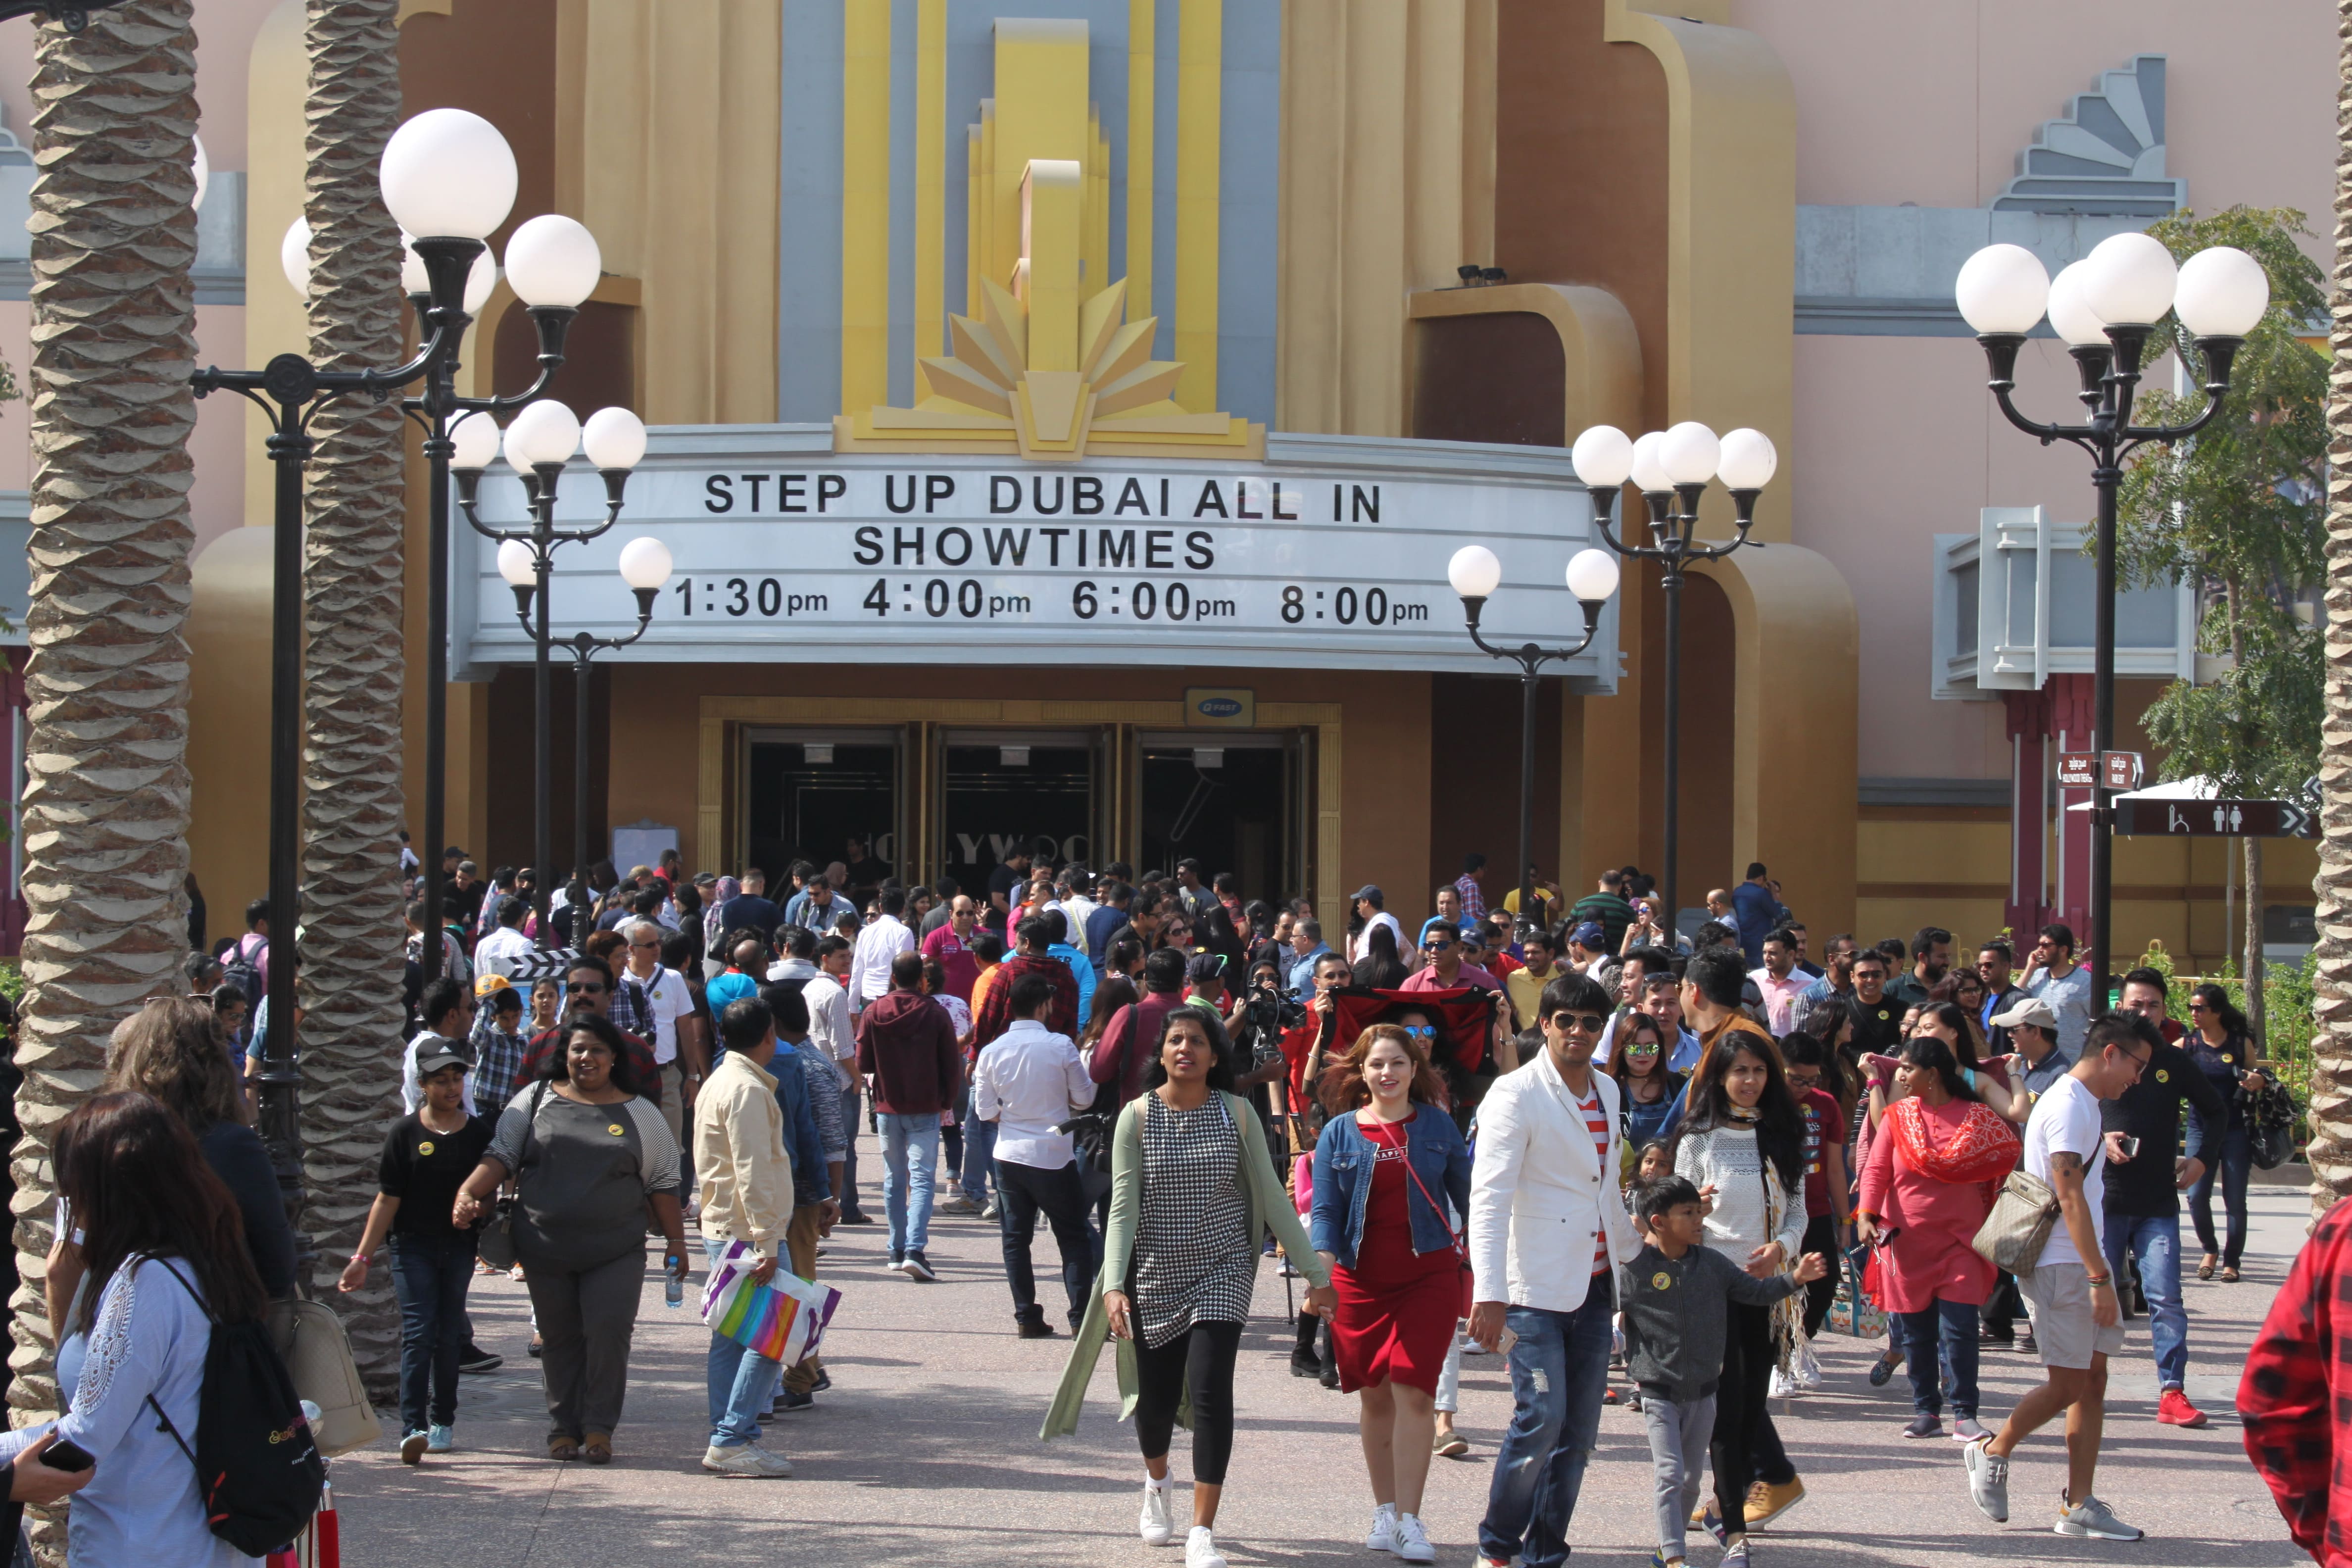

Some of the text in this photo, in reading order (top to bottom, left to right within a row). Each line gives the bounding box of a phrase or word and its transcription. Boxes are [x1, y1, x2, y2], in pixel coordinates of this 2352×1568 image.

[704, 474, 1380, 524] STEP UP DUBAI ALL IN
[853, 526, 1215, 570] SHOWTIMES
[675, 577, 1428, 626] 1:30pm 4:00pm 6:00pm 8:00pm
